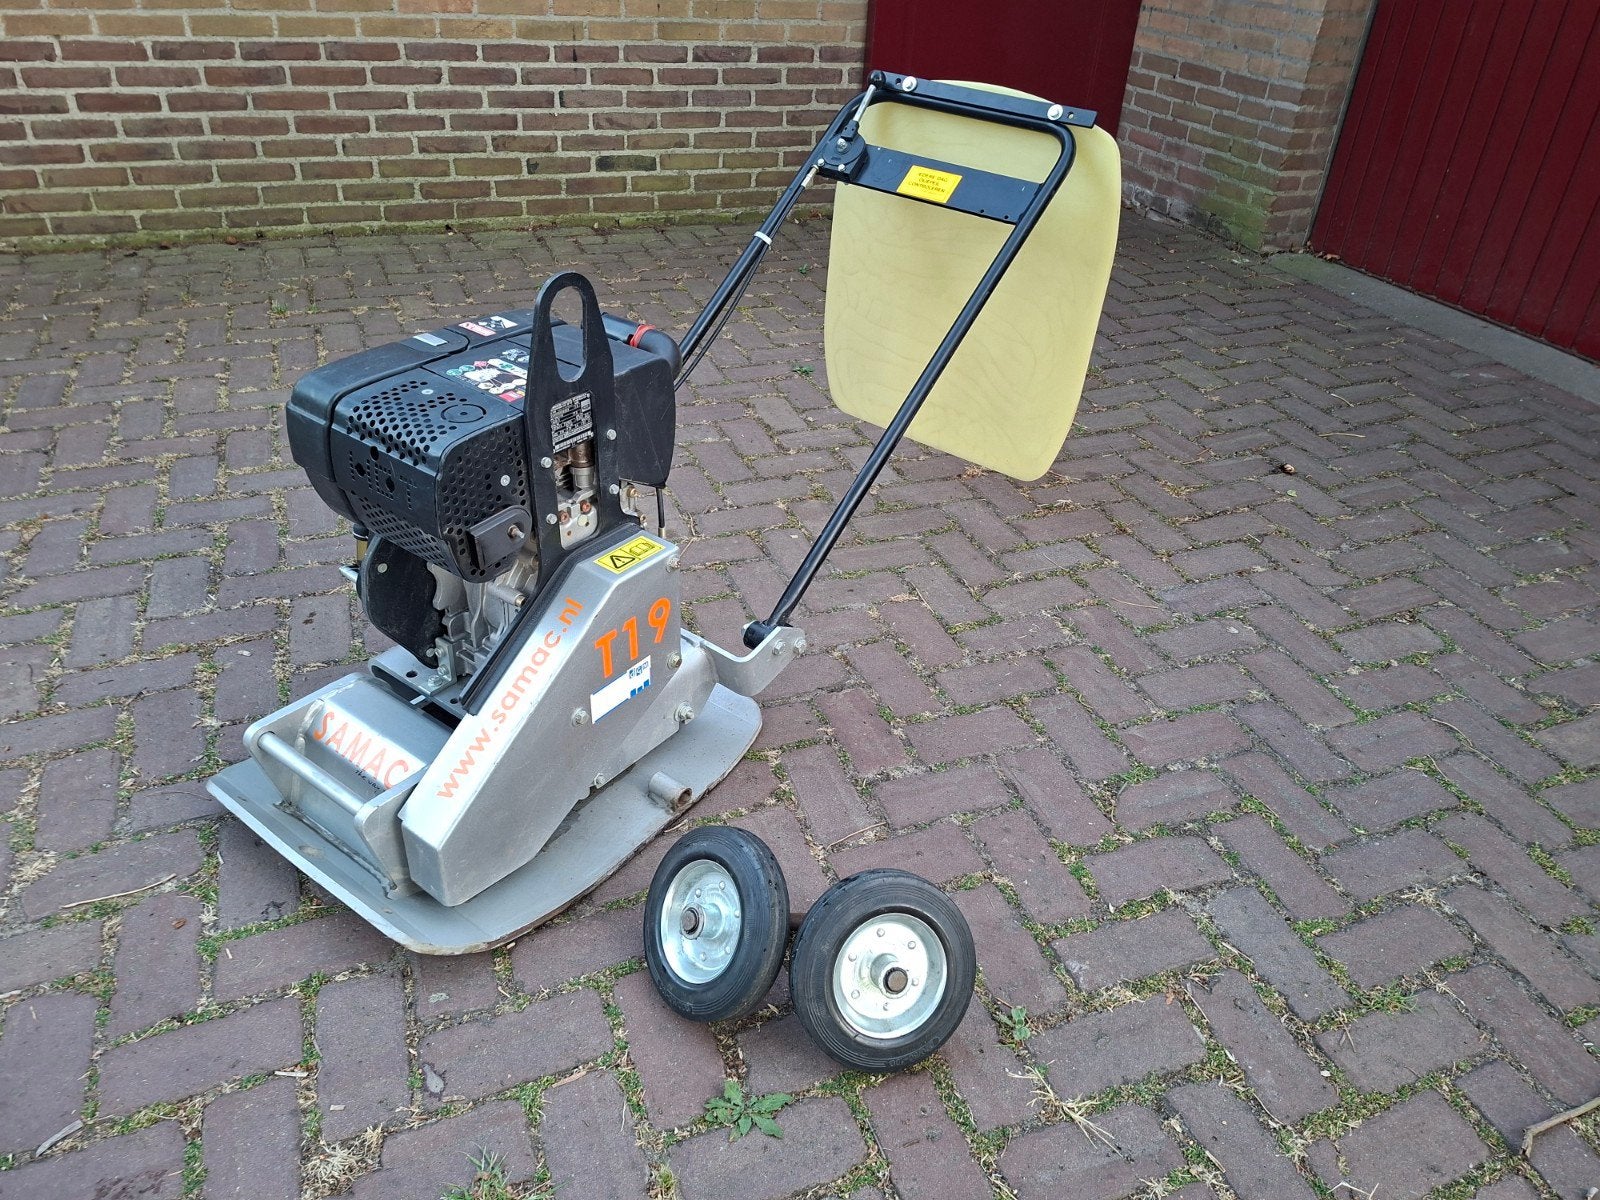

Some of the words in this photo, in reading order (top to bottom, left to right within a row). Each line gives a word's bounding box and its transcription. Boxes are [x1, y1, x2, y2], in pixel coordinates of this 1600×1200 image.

[594, 597, 671, 678] T19
[437, 597, 584, 798] www.samac.nl
[313, 711, 409, 790] SAMAC
